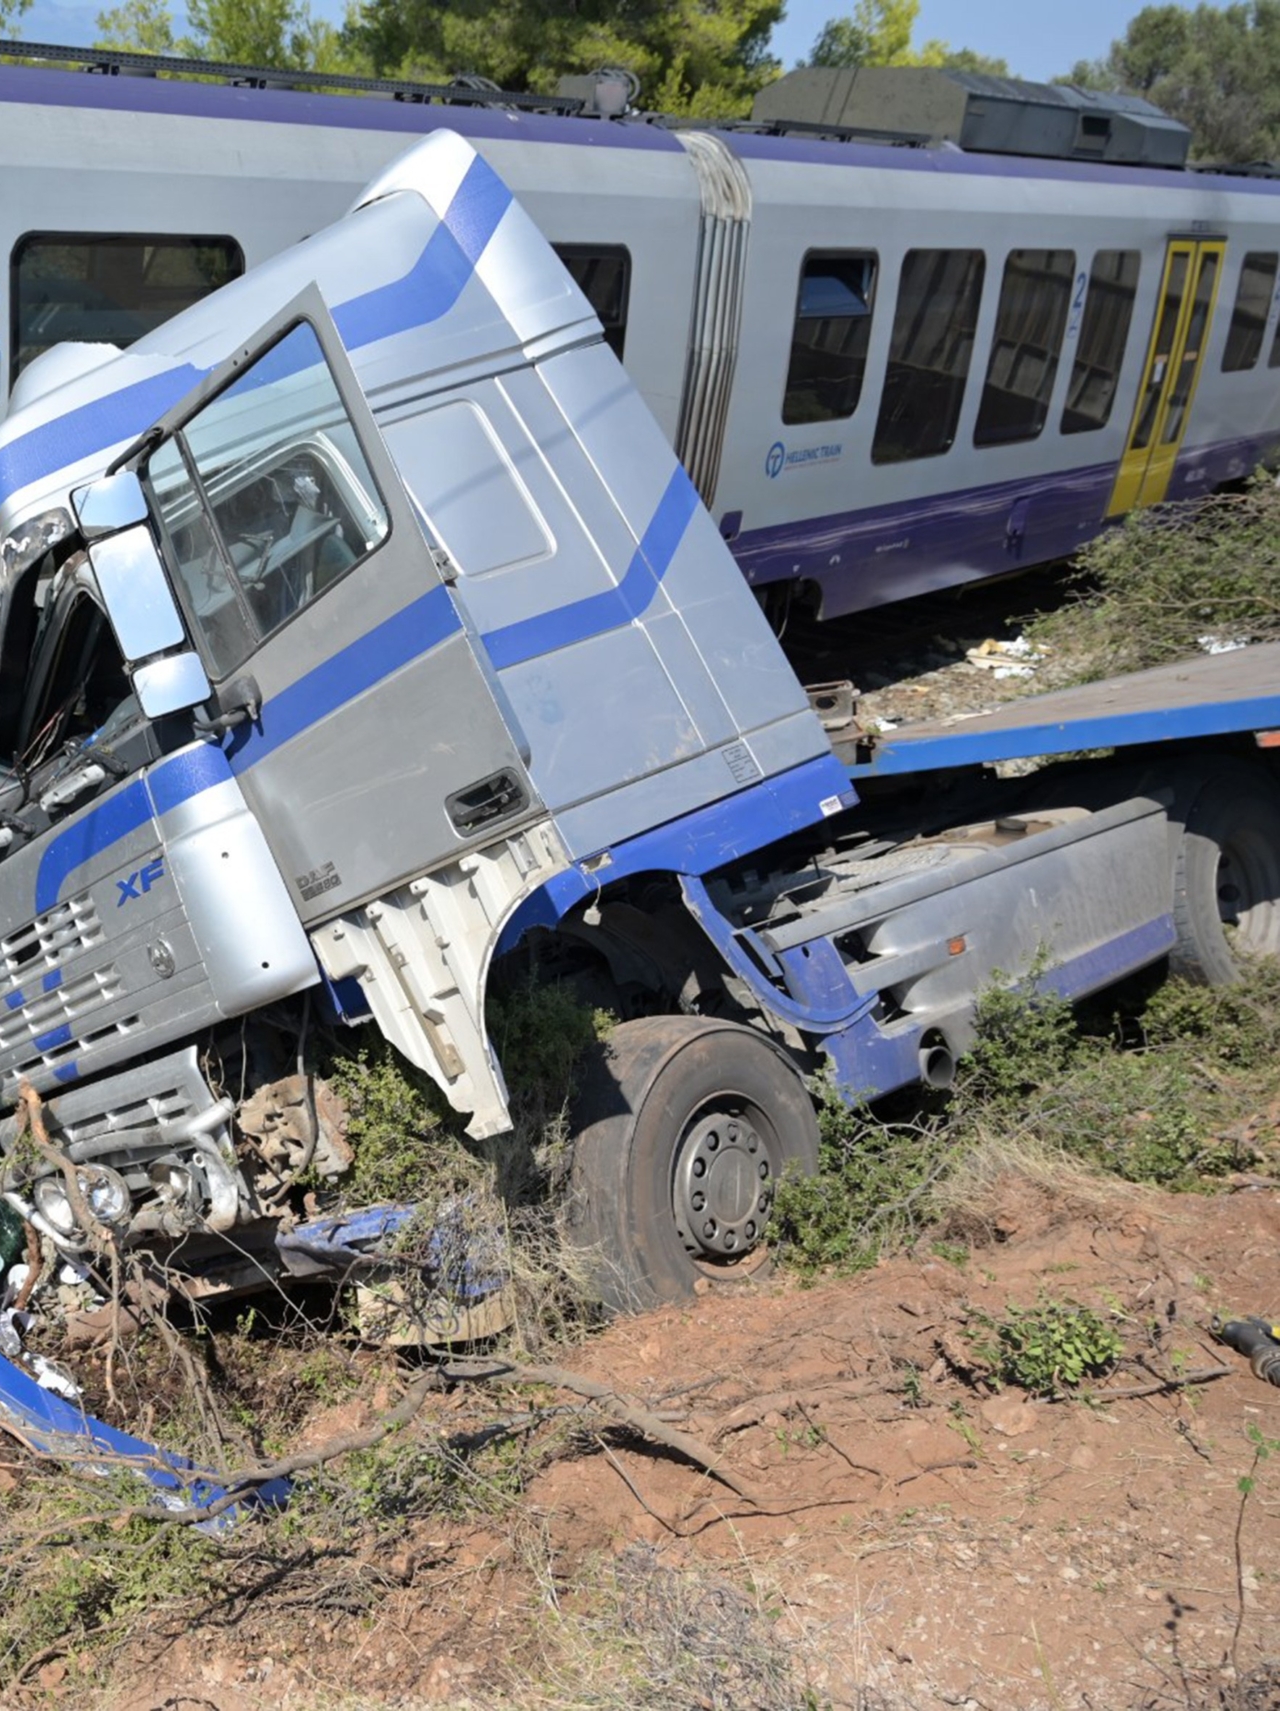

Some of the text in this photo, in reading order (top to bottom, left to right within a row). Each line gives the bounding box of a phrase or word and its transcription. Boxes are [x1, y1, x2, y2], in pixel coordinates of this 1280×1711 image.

[786, 447, 819, 464] HELLENIC
[821, 444, 843, 458] TRAIN
[115, 859, 165, 908] XF
[295, 861, 336, 889] DAF
